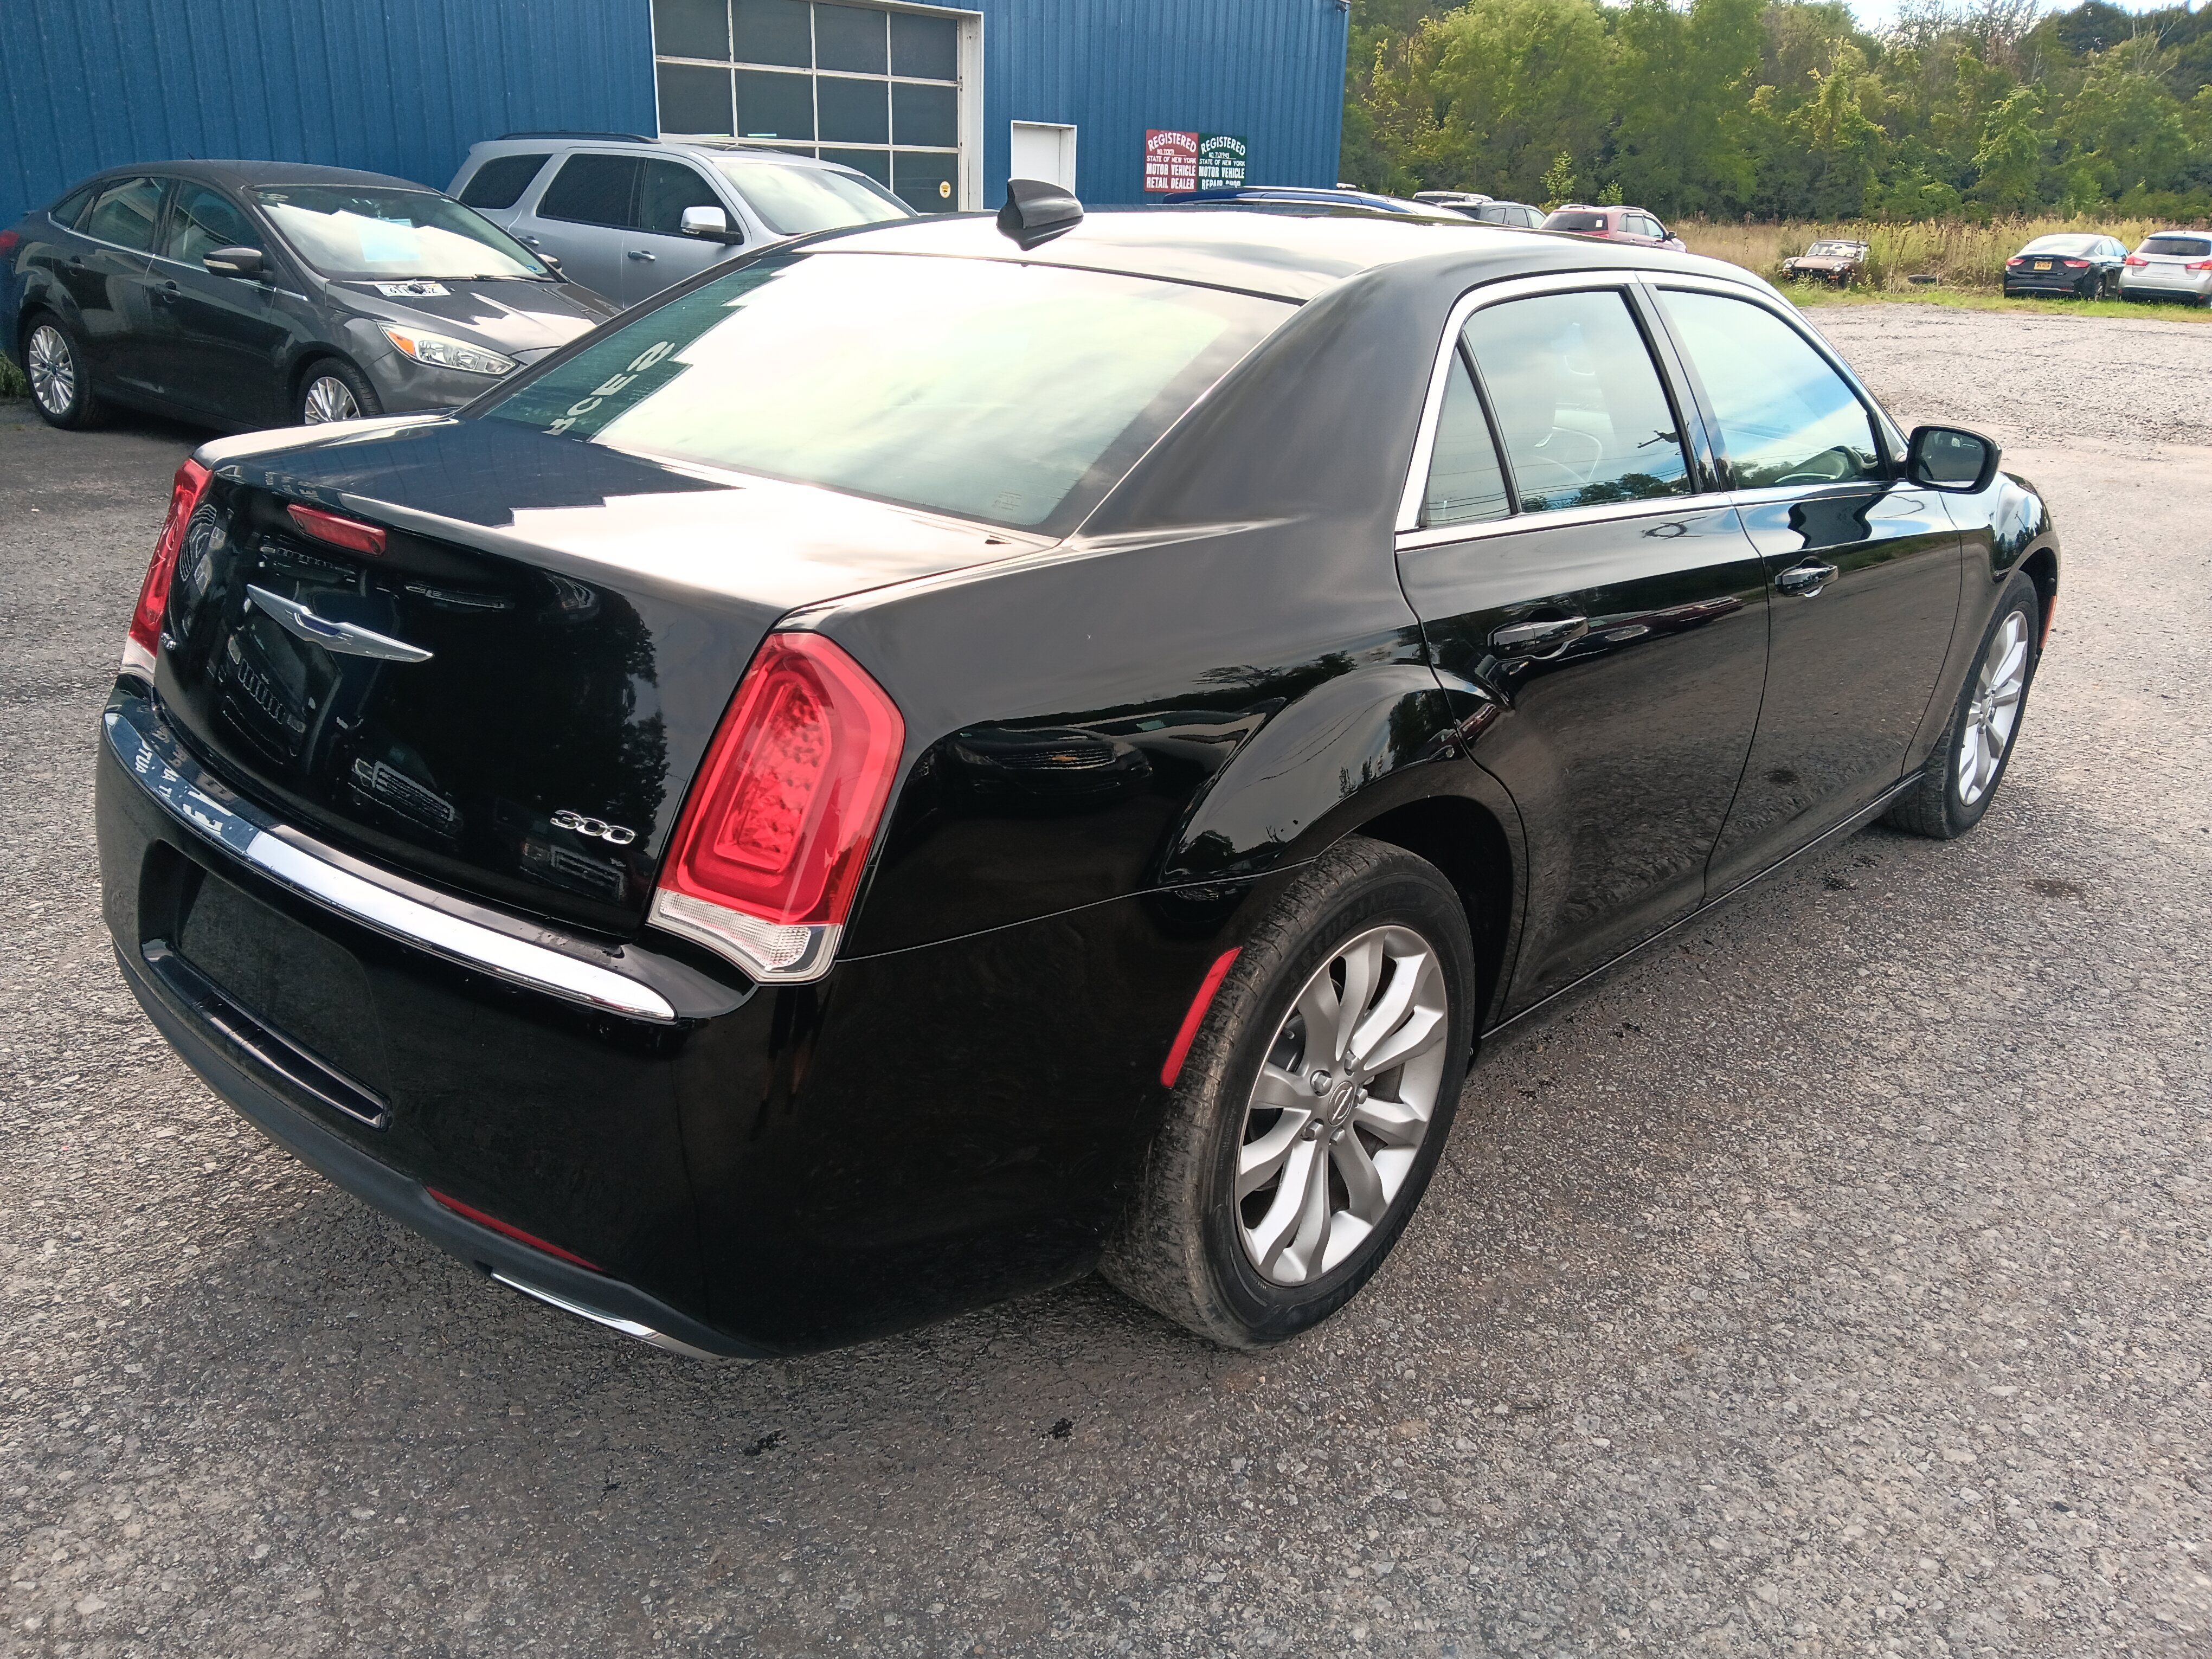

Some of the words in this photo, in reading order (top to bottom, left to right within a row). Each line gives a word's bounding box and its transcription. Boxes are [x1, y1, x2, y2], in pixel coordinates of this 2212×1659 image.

[1148, 132, 1197, 152] REGISTERED
[1201, 136, 1245, 156] REGISTERED
[1146, 163, 1168, 175] MOTOR
[1171, 164, 1195, 176] VEHICLE
[1199, 166, 1219, 177] MOTOR
[1221, 167, 1245, 178] VEHICLE
[1147, 177, 1168, 188] RETAIL
[1171, 178, 1194, 189] DEALER
[550, 810, 636, 844] 300
